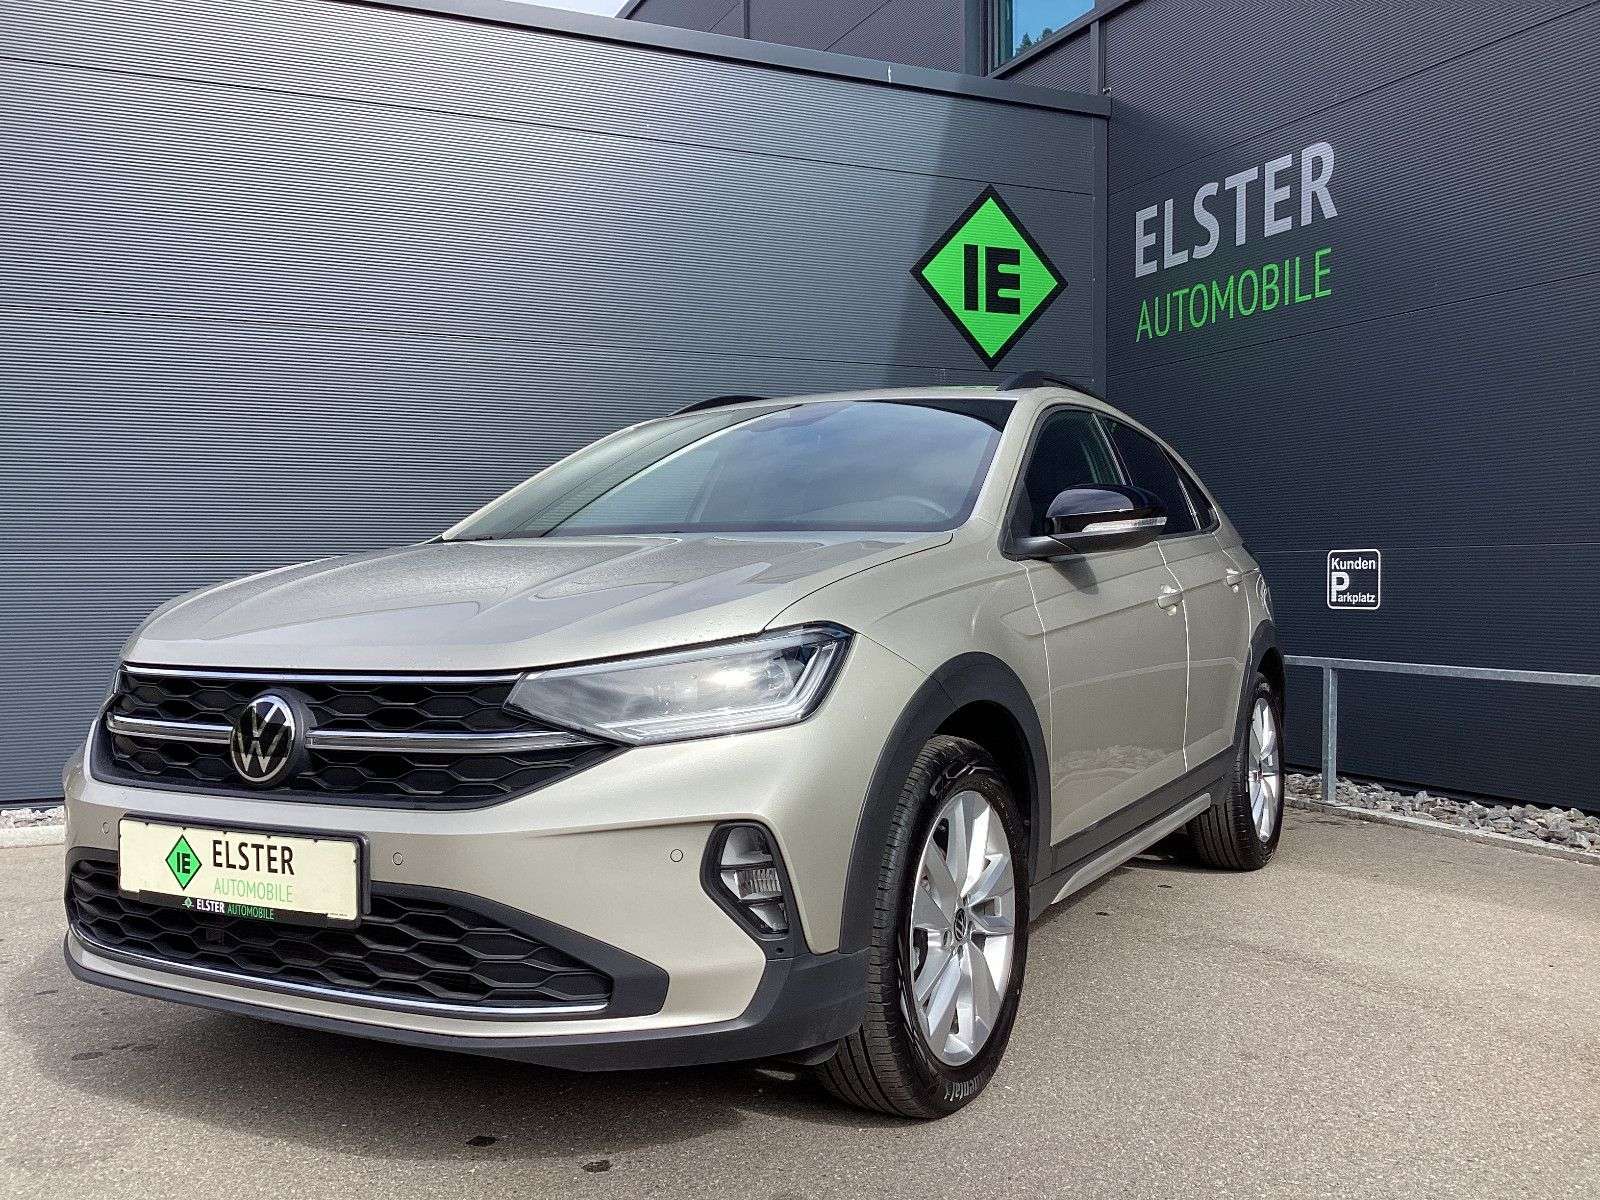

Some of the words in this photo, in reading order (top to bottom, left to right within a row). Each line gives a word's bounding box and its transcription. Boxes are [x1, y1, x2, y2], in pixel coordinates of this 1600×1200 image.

[1134, 141, 1338, 278] ELSTER
[963, 243, 1021, 315] IE
[1135, 247, 1332, 343] AUTOMOBILE
[1331, 557, 1376, 570] Kunden
[176, 851, 191, 874] IE
[212, 840, 295, 875] ELSTER
[213, 878, 294, 903] AUTOMOBILE
[196, 898, 225, 914] ELSTER
[227, 903, 275, 920] AUTOMOBILE
